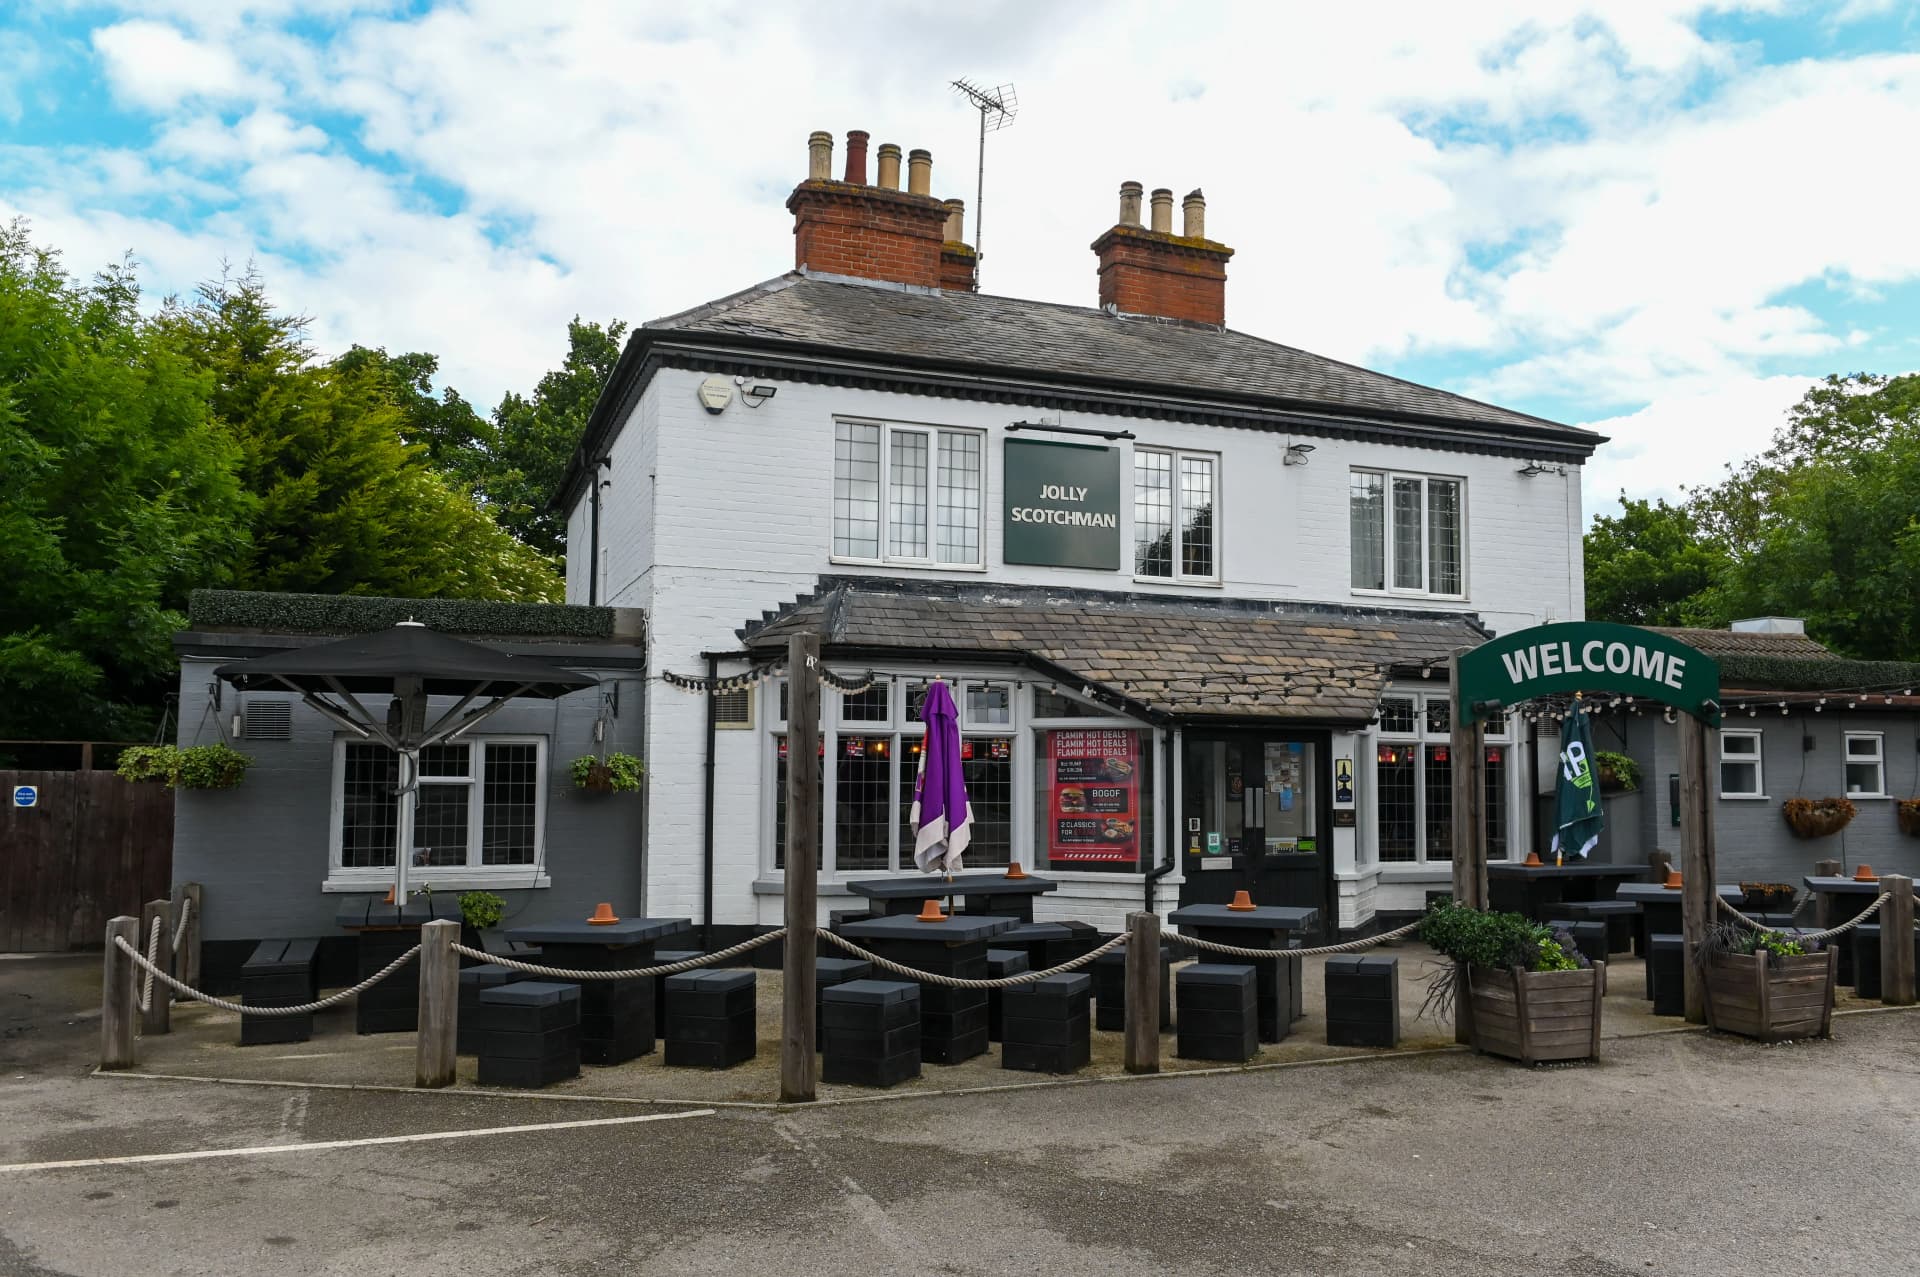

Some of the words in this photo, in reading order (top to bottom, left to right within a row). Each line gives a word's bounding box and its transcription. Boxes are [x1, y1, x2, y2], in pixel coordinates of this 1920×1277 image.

[1040, 485, 1088, 501] JOLLY
[1011, 507, 1116, 528] SCOTCHMAN
[1501, 640, 1686, 689] WELCOME
[1087, 731, 1101, 739] HOT
[1103, 730, 1127, 739] DEALS
[1103, 739, 1127, 747] DEALS
[1087, 748, 1101, 757] HOT
[1103, 748, 1127, 756] DEALS
[1092, 789, 1121, 798] BOGOF
